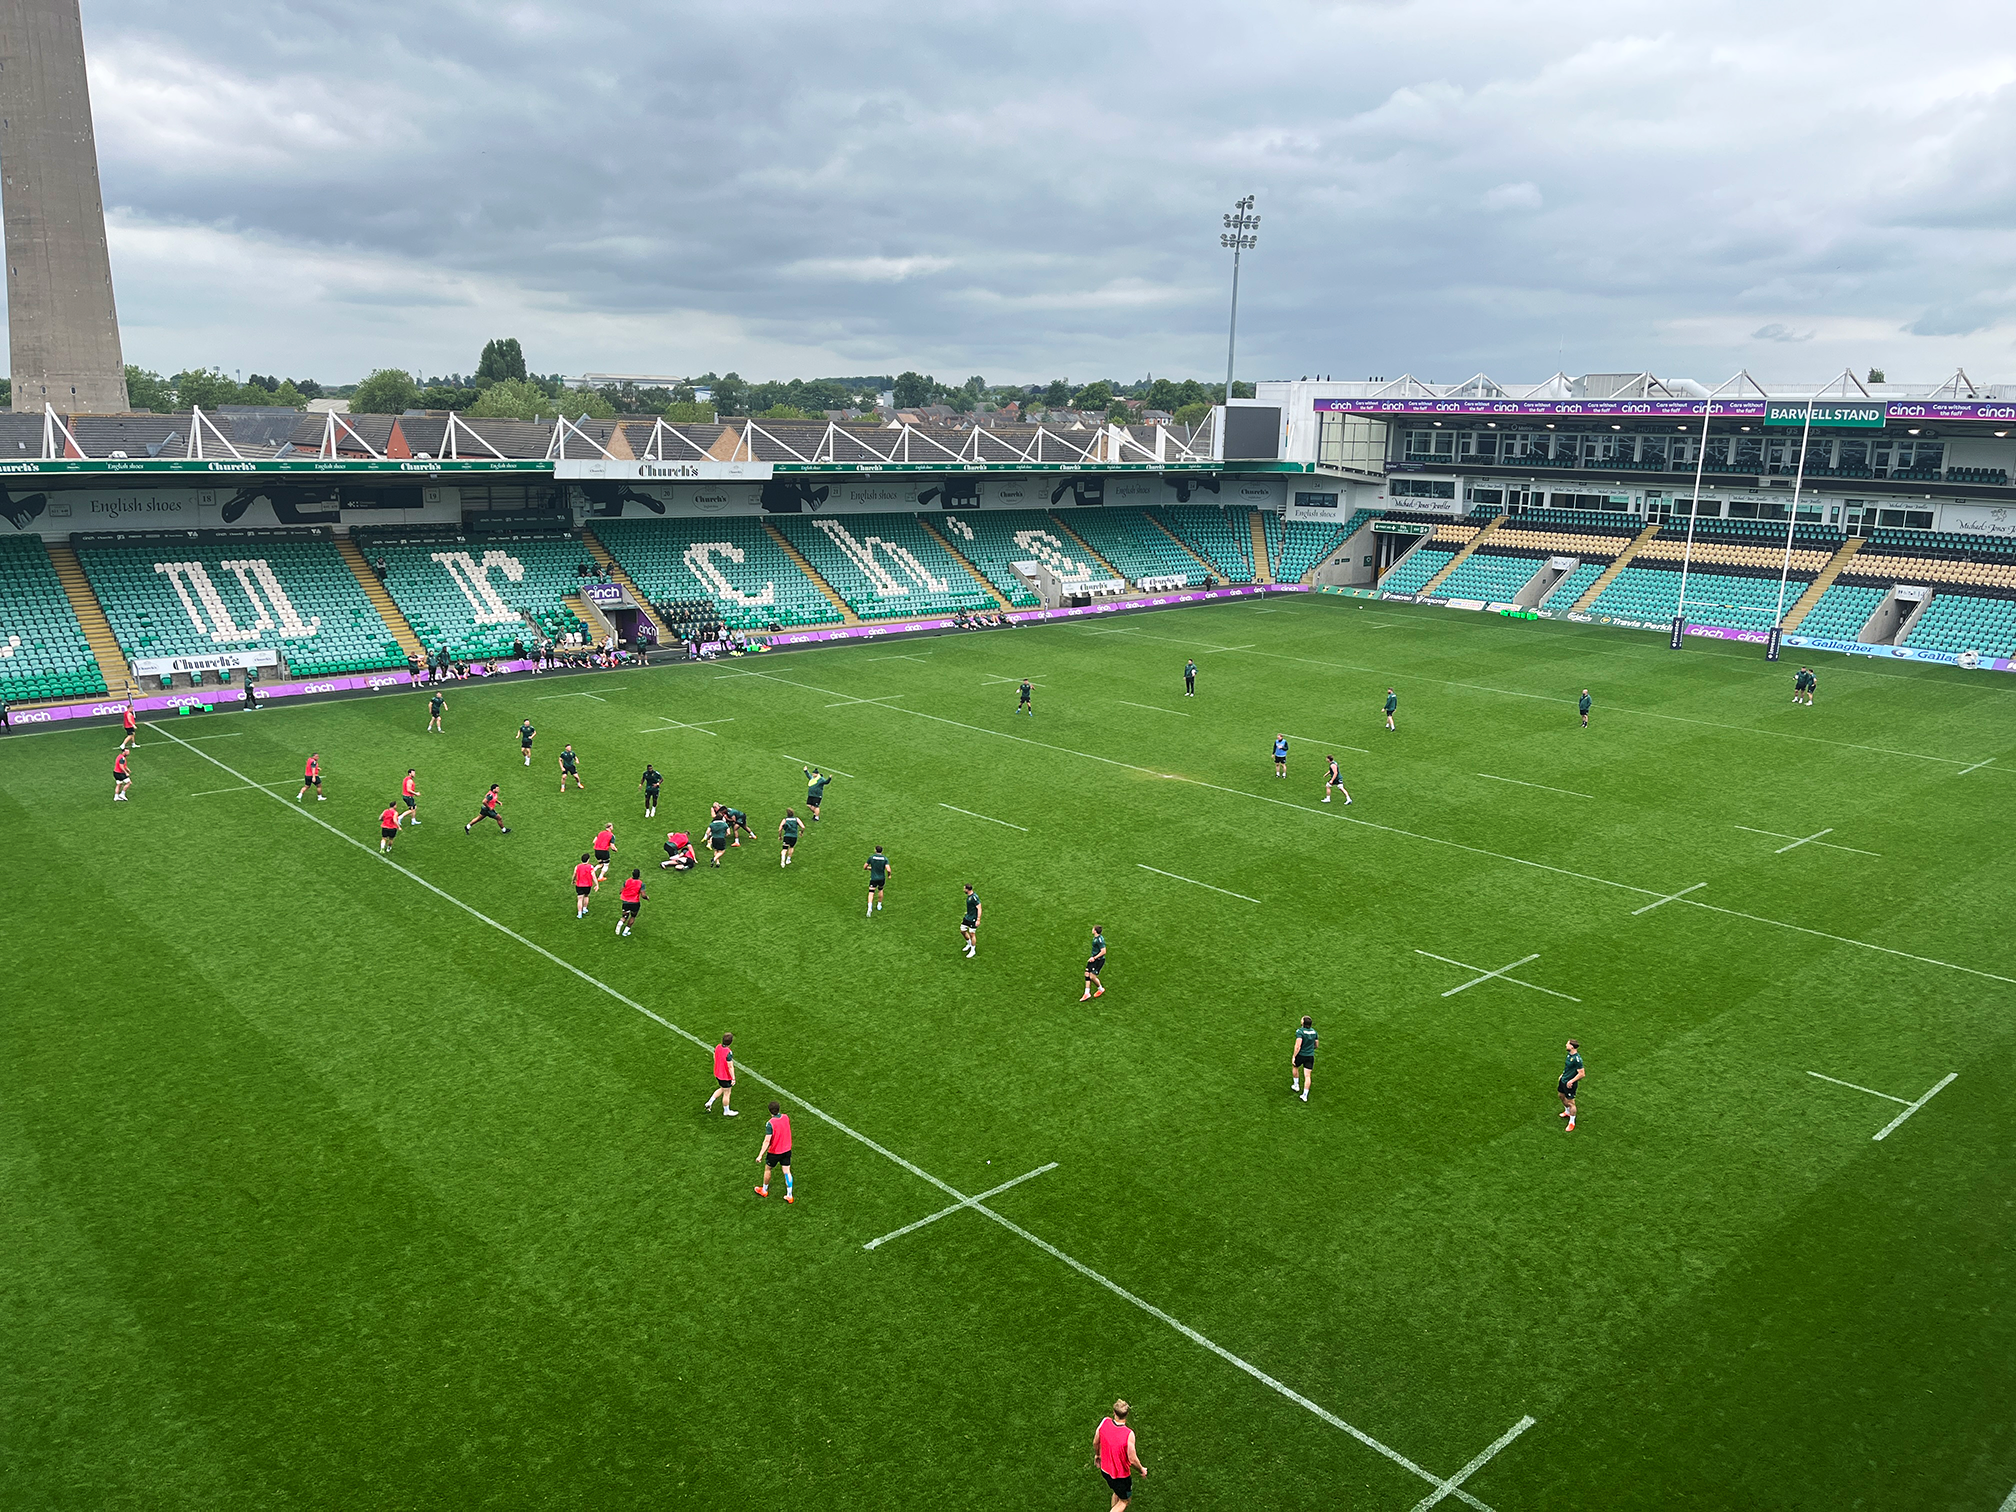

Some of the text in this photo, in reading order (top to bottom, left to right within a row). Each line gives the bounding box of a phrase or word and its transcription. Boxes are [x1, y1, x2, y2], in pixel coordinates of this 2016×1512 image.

[1330, 400, 1352, 410] cinch
[1381, 400, 1404, 410] cinch
[1436, 400, 1460, 411] cinch
[1493, 401, 1519, 412] cinch
[1555, 401, 1582, 413] cinch
[1621, 401, 1650, 413] cinch
[1889, 403, 1925, 416] cinch
[1948, 404, 1972, 412] without
[1977, 403, 2015, 418] cinch
[1770, 408, 1880, 421] BARWELL STAND
[107, 463, 128, 471] English
[208, 462, 257, 471] Church's
[400, 462, 442, 471] Church's
[638, 464, 699, 477] Church's
[850, 491, 897, 504] English shoes
[1115, 486, 1135, 498] English
[202, 495, 211, 503] 18
[694, 495, 727, 503] Church's
[1392, 497, 1451, 510] Michael Jones Jeweller
[90, 497, 182, 519] English shoes
[1295, 509, 1336, 519] English shoes
[1956, 519, 1987, 531] Michael
[1988, 523, 2006, 533] Jones
[587, 585, 620, 599] cinch
[1080, 582, 1108, 591] Church's
[1566, 611, 1592, 622] Carlsberg
[638, 622, 657, 636] cinch
[1612, 617, 1673, 631] Travis Perki
[829, 631, 849, 640] cinch
[1690, 626, 1724, 638] cinch
[790, 635, 810, 643] cinch
[1768, 630, 1777, 655] Investec
[1812, 639, 1874, 653] Gallagher
[172, 655, 240, 671] Church's
[1917, 651, 1984, 666] Gallagr
[368, 676, 398, 687] cinch
[304, 682, 335, 694] cinch
[237, 689, 270, 701] cich
[166, 696, 200, 708] cinch
[92, 704, 128, 716] cinch
[14, 711, 51, 724] cinch
